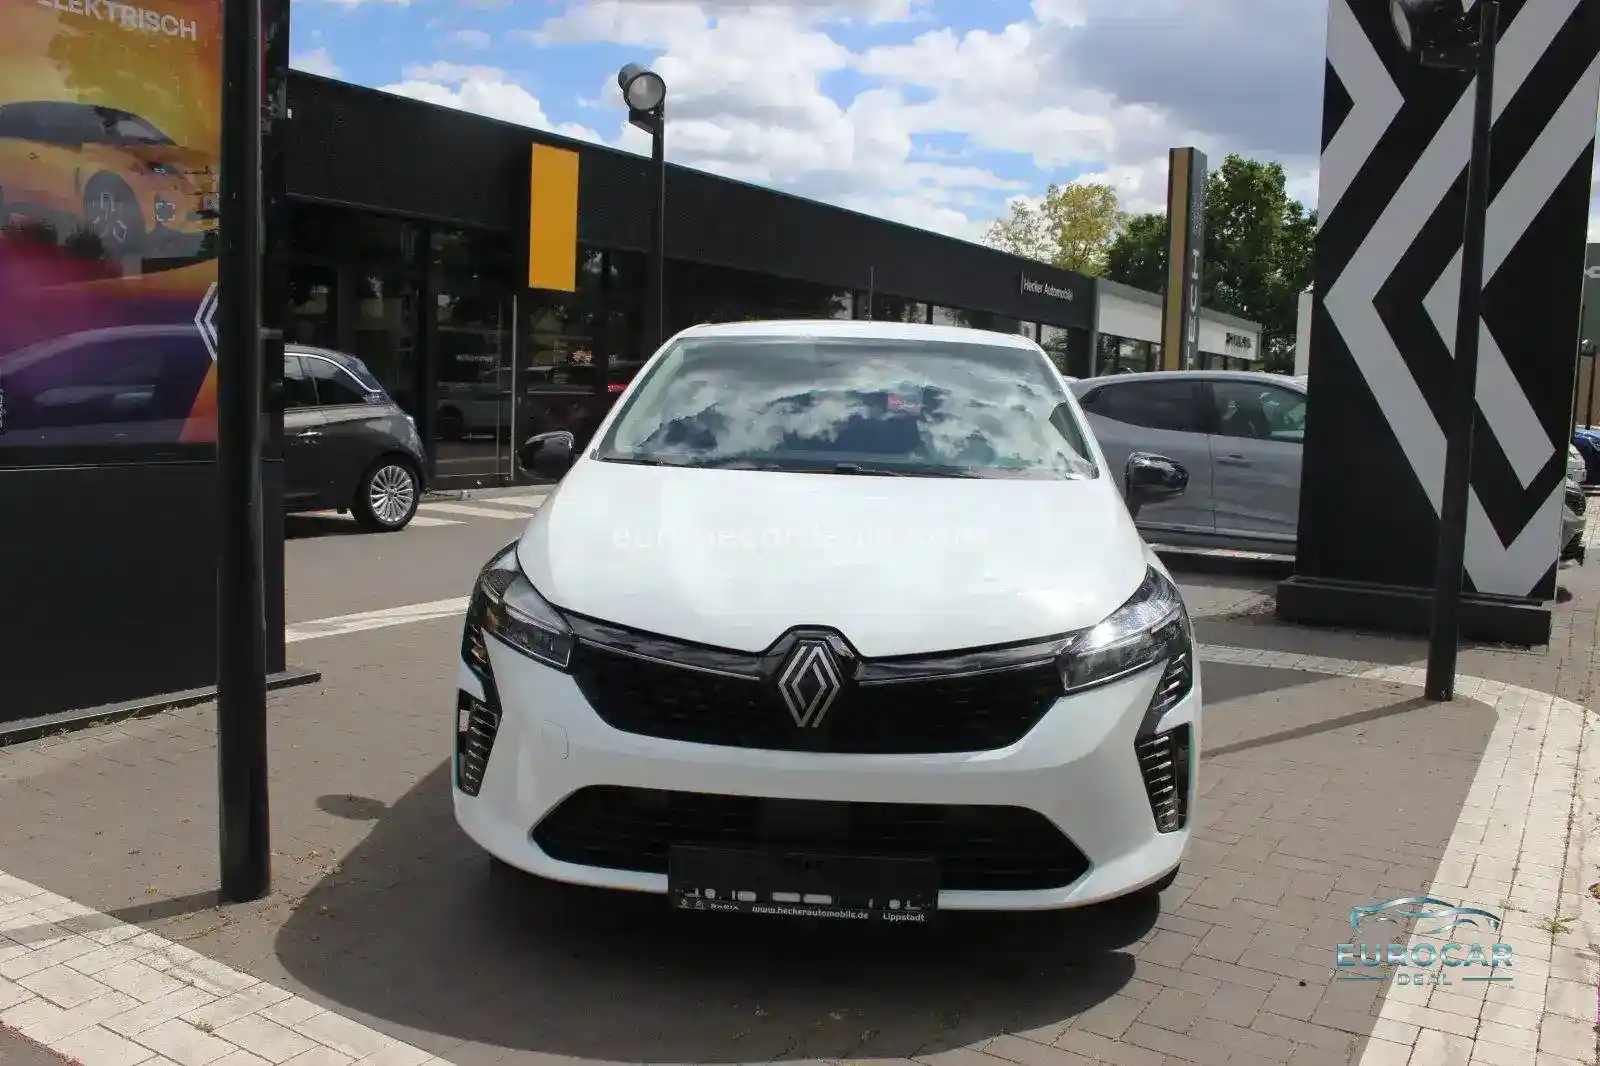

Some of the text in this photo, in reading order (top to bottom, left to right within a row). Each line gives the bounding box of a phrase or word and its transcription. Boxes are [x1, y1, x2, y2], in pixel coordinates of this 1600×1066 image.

[37, 0, 196, 41] LEKTRISCH
[752, 905, 868, 919] www.heckerautomobile.de
[883, 912, 925, 922] Lippstadt
